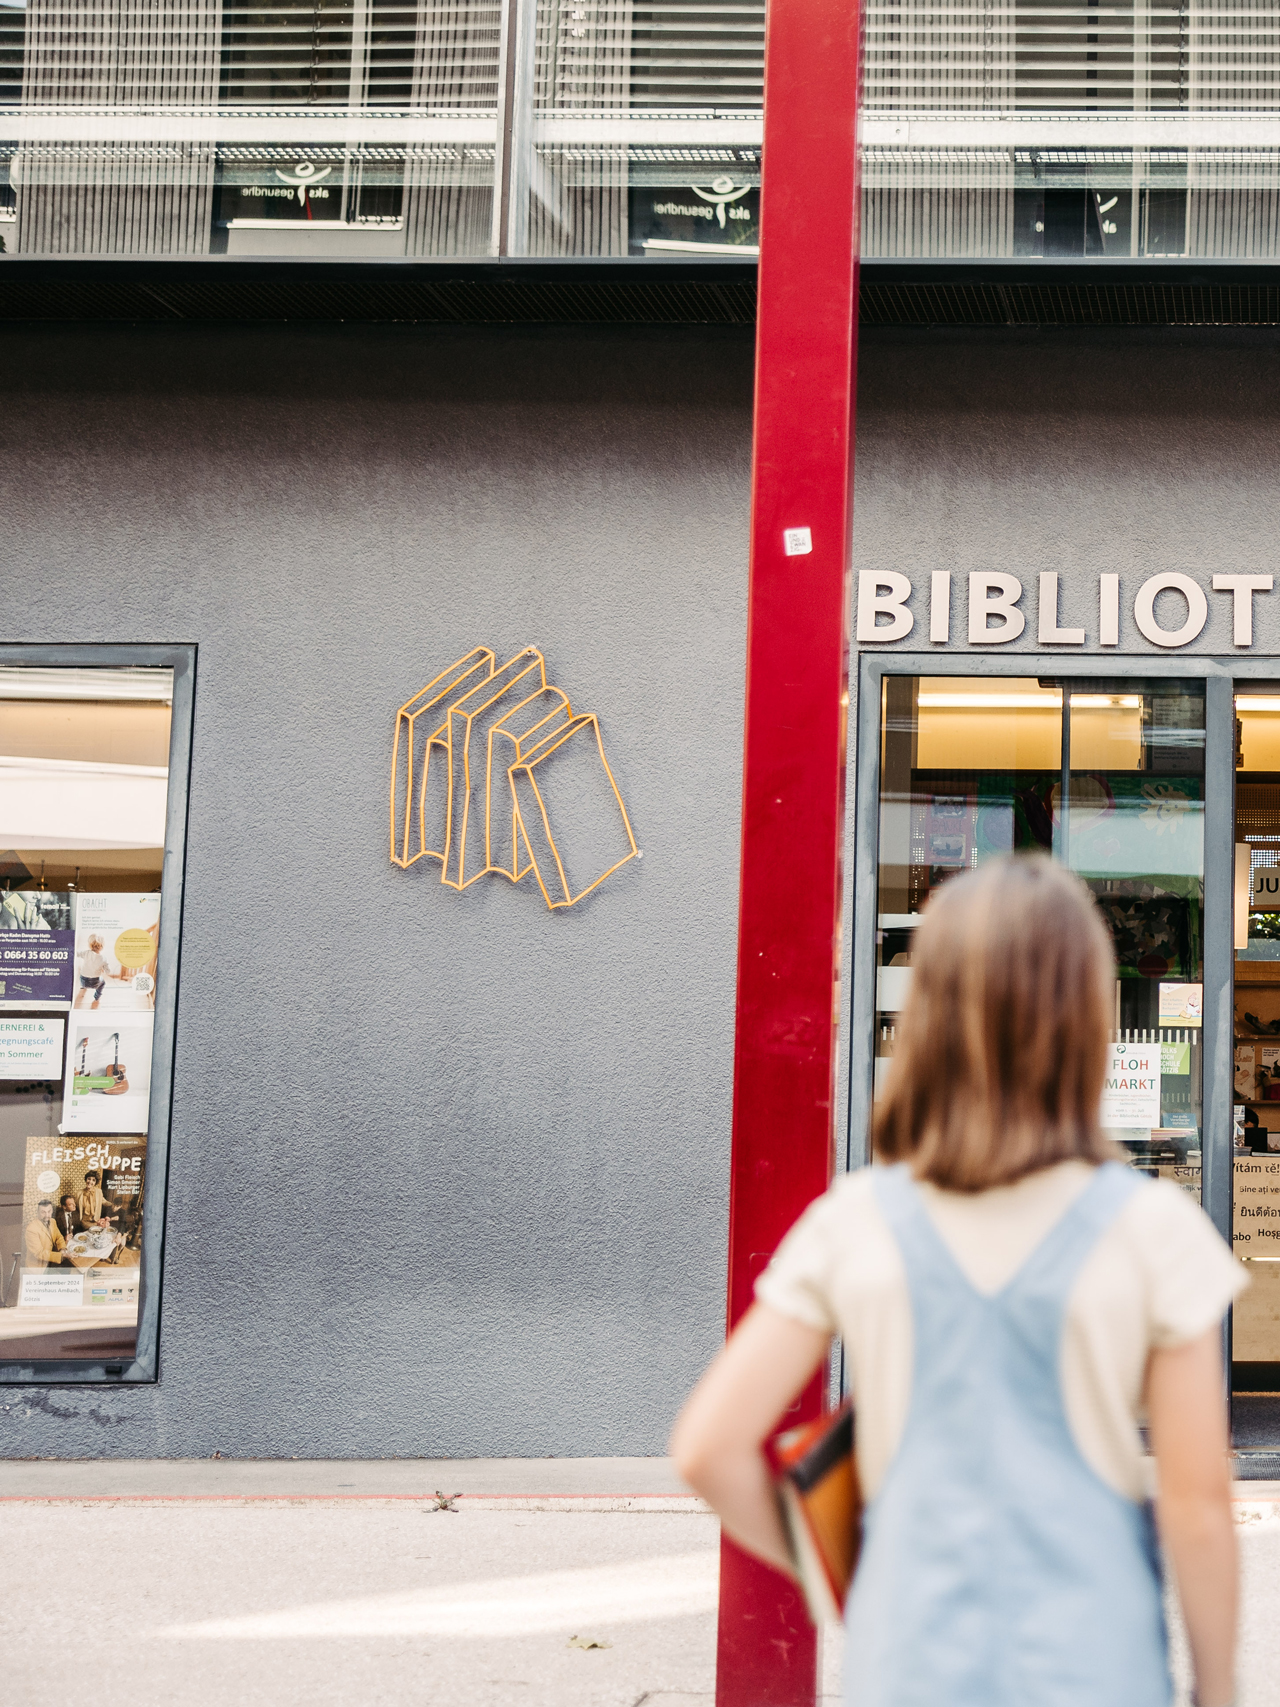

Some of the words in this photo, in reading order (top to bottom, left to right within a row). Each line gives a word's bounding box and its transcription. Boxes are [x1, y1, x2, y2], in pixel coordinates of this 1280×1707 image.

[82, 898, 108, 909] OBACHT
[4, 950, 26, 960] 0664
[27, 951, 38, 960] 35
[39, 951, 51, 960] 60
[52, 951, 68, 960] 603
[1113, 1059, 1149, 1070] FLOH
[1105, 1079, 1156, 1090] MARKT
[32, 1143, 110, 1166] FLEISCH
[87, 1156, 142, 1172] SUPPE
